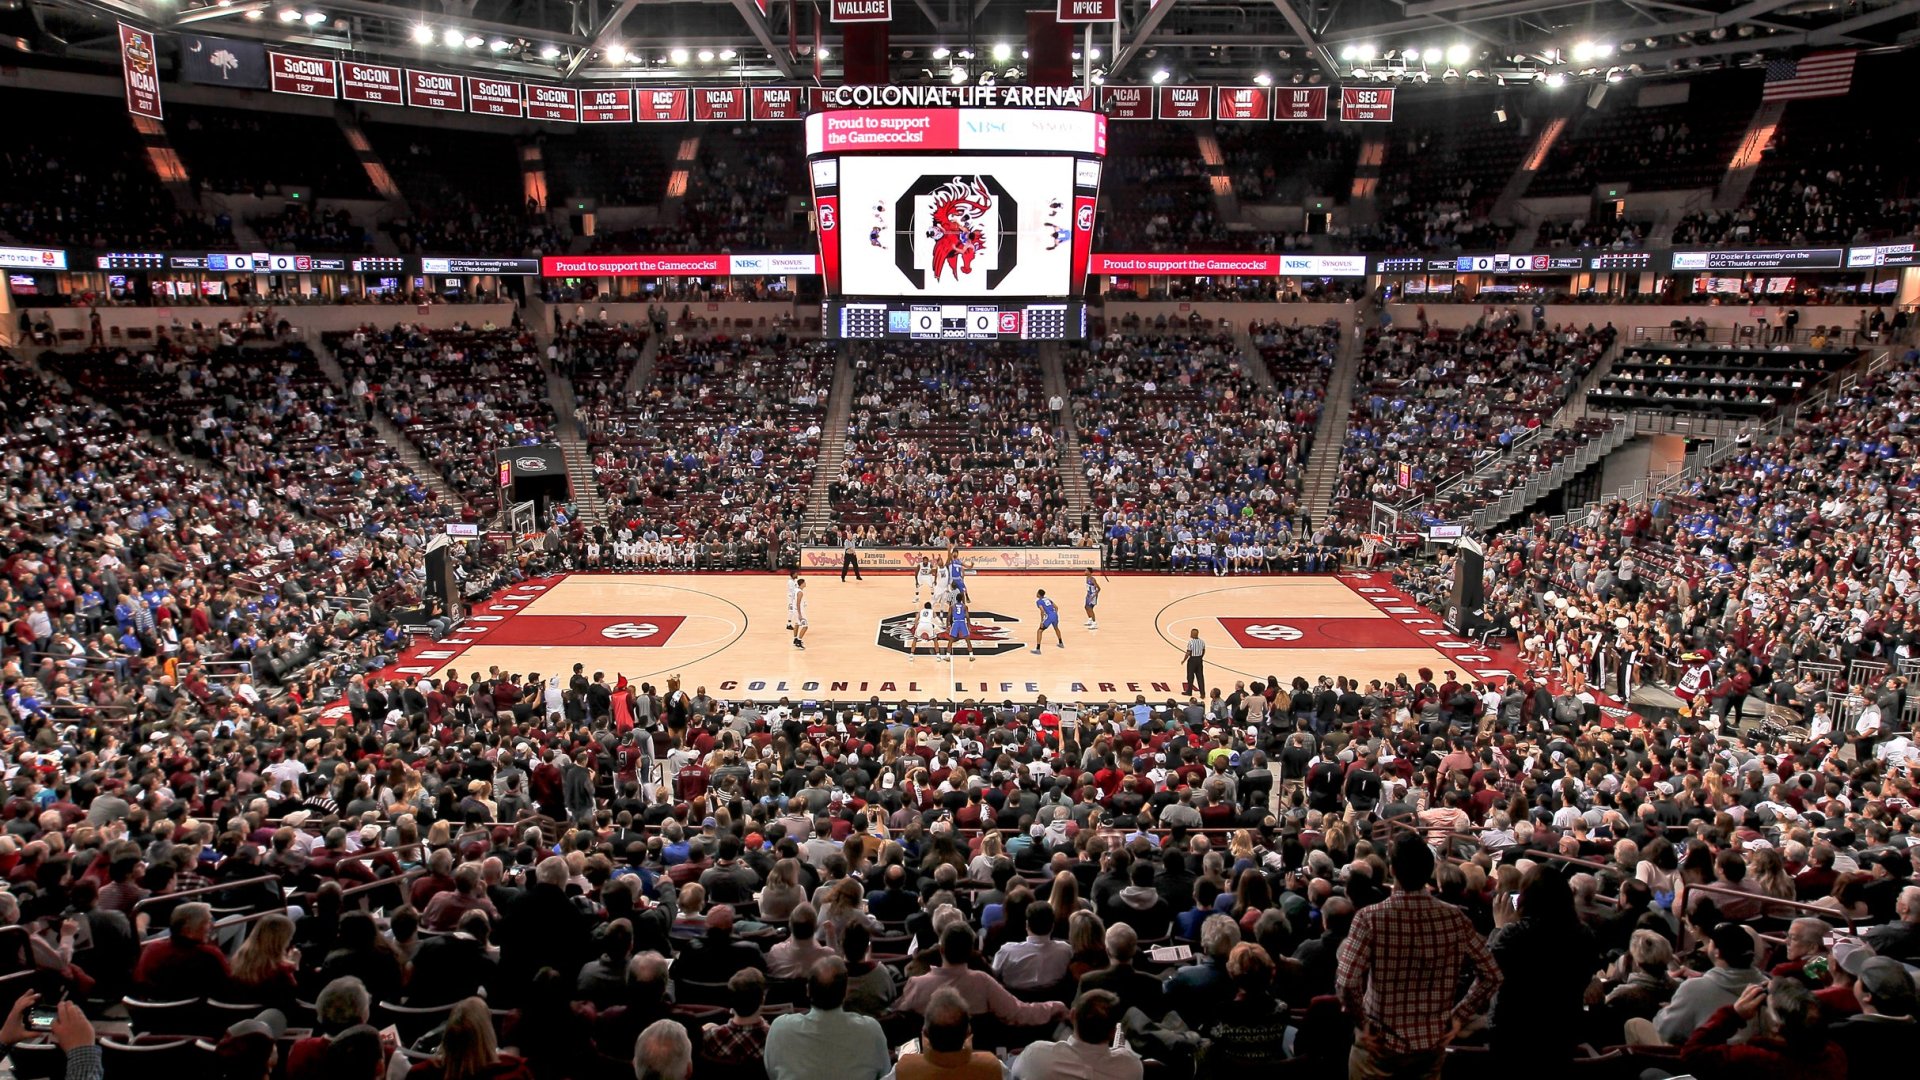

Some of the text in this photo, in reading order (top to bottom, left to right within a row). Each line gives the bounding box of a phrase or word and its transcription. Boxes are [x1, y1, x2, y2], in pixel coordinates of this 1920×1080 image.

[838, 1, 884, 14] WALLACE
[284, 59, 324, 76] SoCON
[130, 70, 156, 92] NCAA
[353, 67, 390, 84] SoCON
[296, 84, 314, 92] 1927
[418, 75, 452, 90] SoCON
[366, 91, 382, 100] 1933
[479, 82, 511, 97] SoCON
[1114, 89, 1140, 101] NCAA
[429, 98, 444, 106] 1933
[536, 89, 568, 104] SoCON
[596, 92, 616, 104] ACC
[652, 92, 673, 104] ACC
[706, 90, 734, 103] NCAA
[764, 90, 790, 102] NCAA
[836, 86, 1080, 106] COLONIAL LIFE ARENA
[1172, 90, 1199, 102] NCAA
[1236, 90, 1252, 102] NIT
[1294, 91, 1309, 102] NIT
[1359, 92, 1378, 104] SEC
[139, 100, 152, 110] 2017
[546, 110, 560, 118] 1945
[828, 116, 930, 130] Proud to support
[828, 131, 922, 144] the Gamecocks!
[236, 258, 245, 268] 0
[278, 258, 287, 268] 0
[556, 261, 716, 272] Proud to support the Gamecocks!
[1104, 260, 1266, 270] Proud to support the Gamecocks!
[1285, 260, 1312, 268] NBSC
[1479, 259, 1487, 269] 0
[1516, 258, 1525, 268] 0
[920, 316, 932, 330] 0
[978, 316, 988, 330] 0
[720, 682, 922, 692] COLONIAL
[955, 682, 1040, 692] LIFE
[455, 703, 464, 712] 44
[840, 733, 850, 744] 17
[619, 751, 628, 766] 9
[1328, 772, 1330, 783] 1
[1362, 780, 1366, 791] 1
